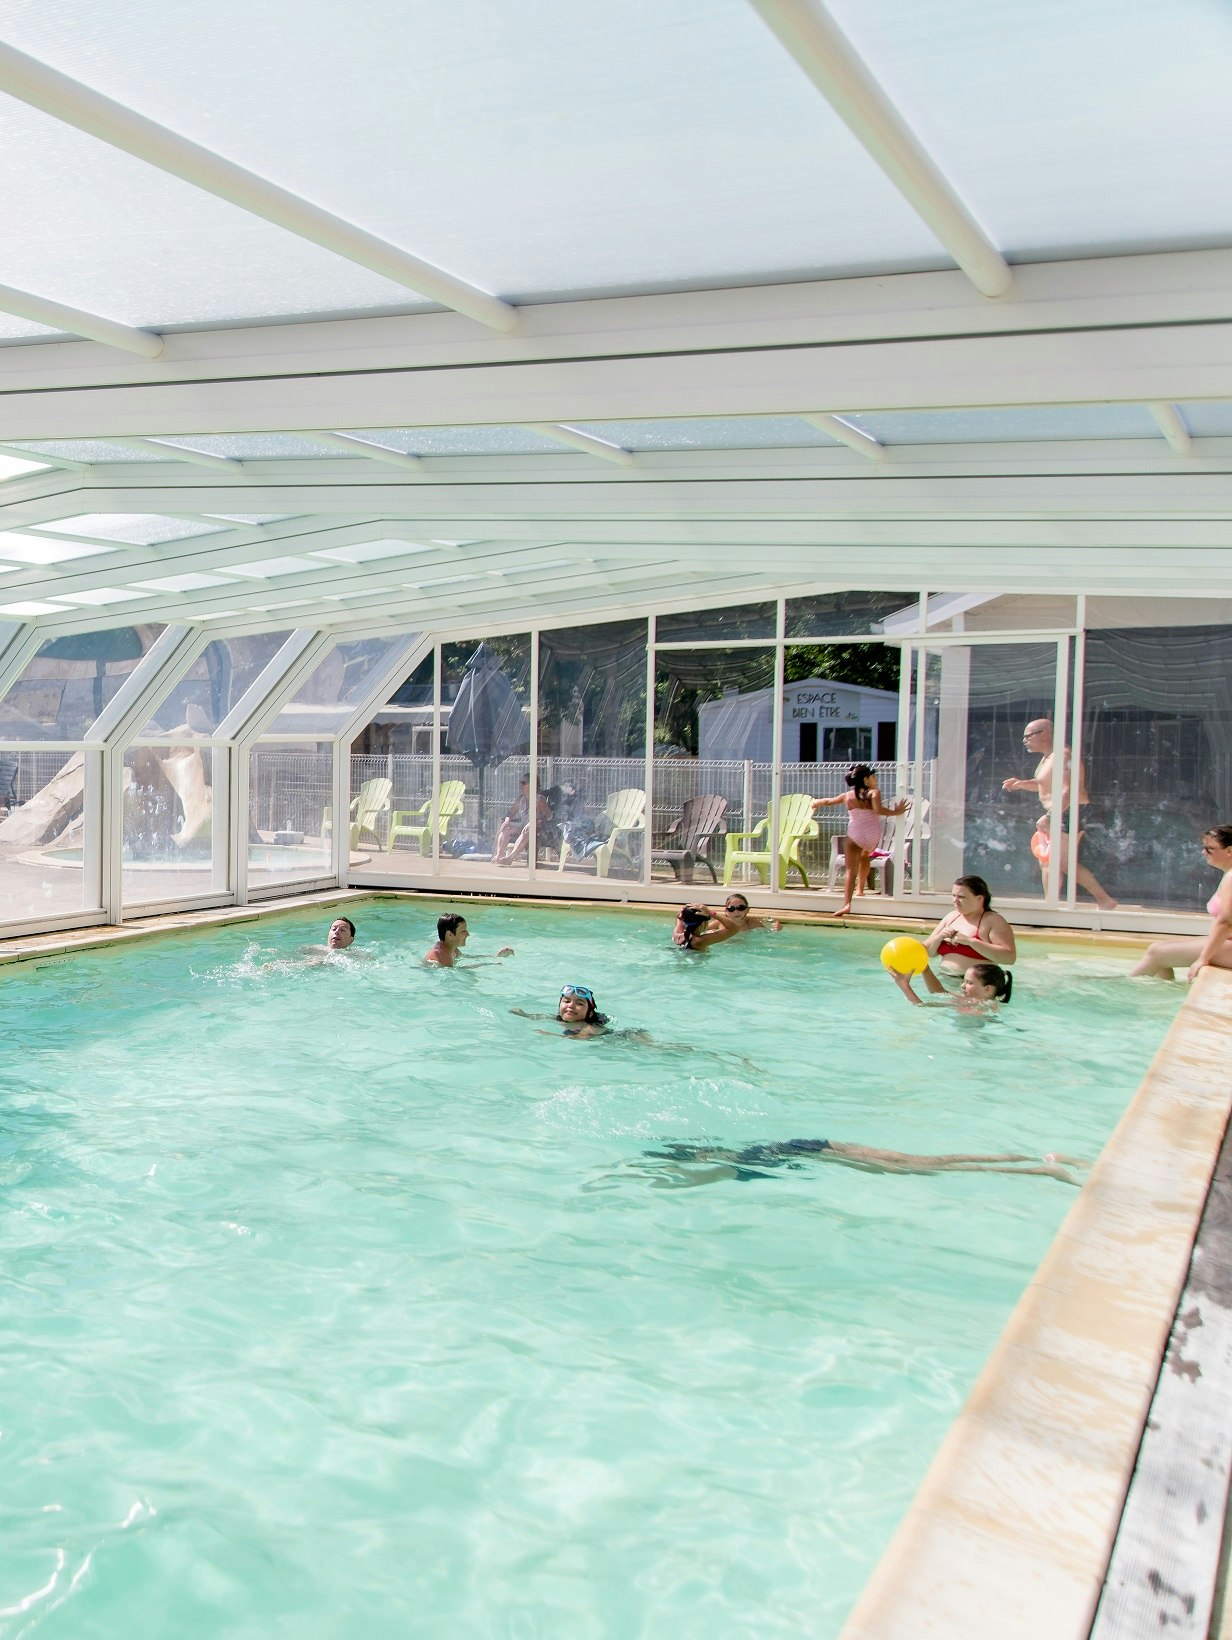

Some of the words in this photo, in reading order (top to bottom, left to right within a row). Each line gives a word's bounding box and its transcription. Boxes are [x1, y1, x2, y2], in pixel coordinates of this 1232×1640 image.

[797, 693, 837, 704] ESPACE
[792, 707, 815, 719] BIEN
[819, 705, 840, 719] ÊTRE
